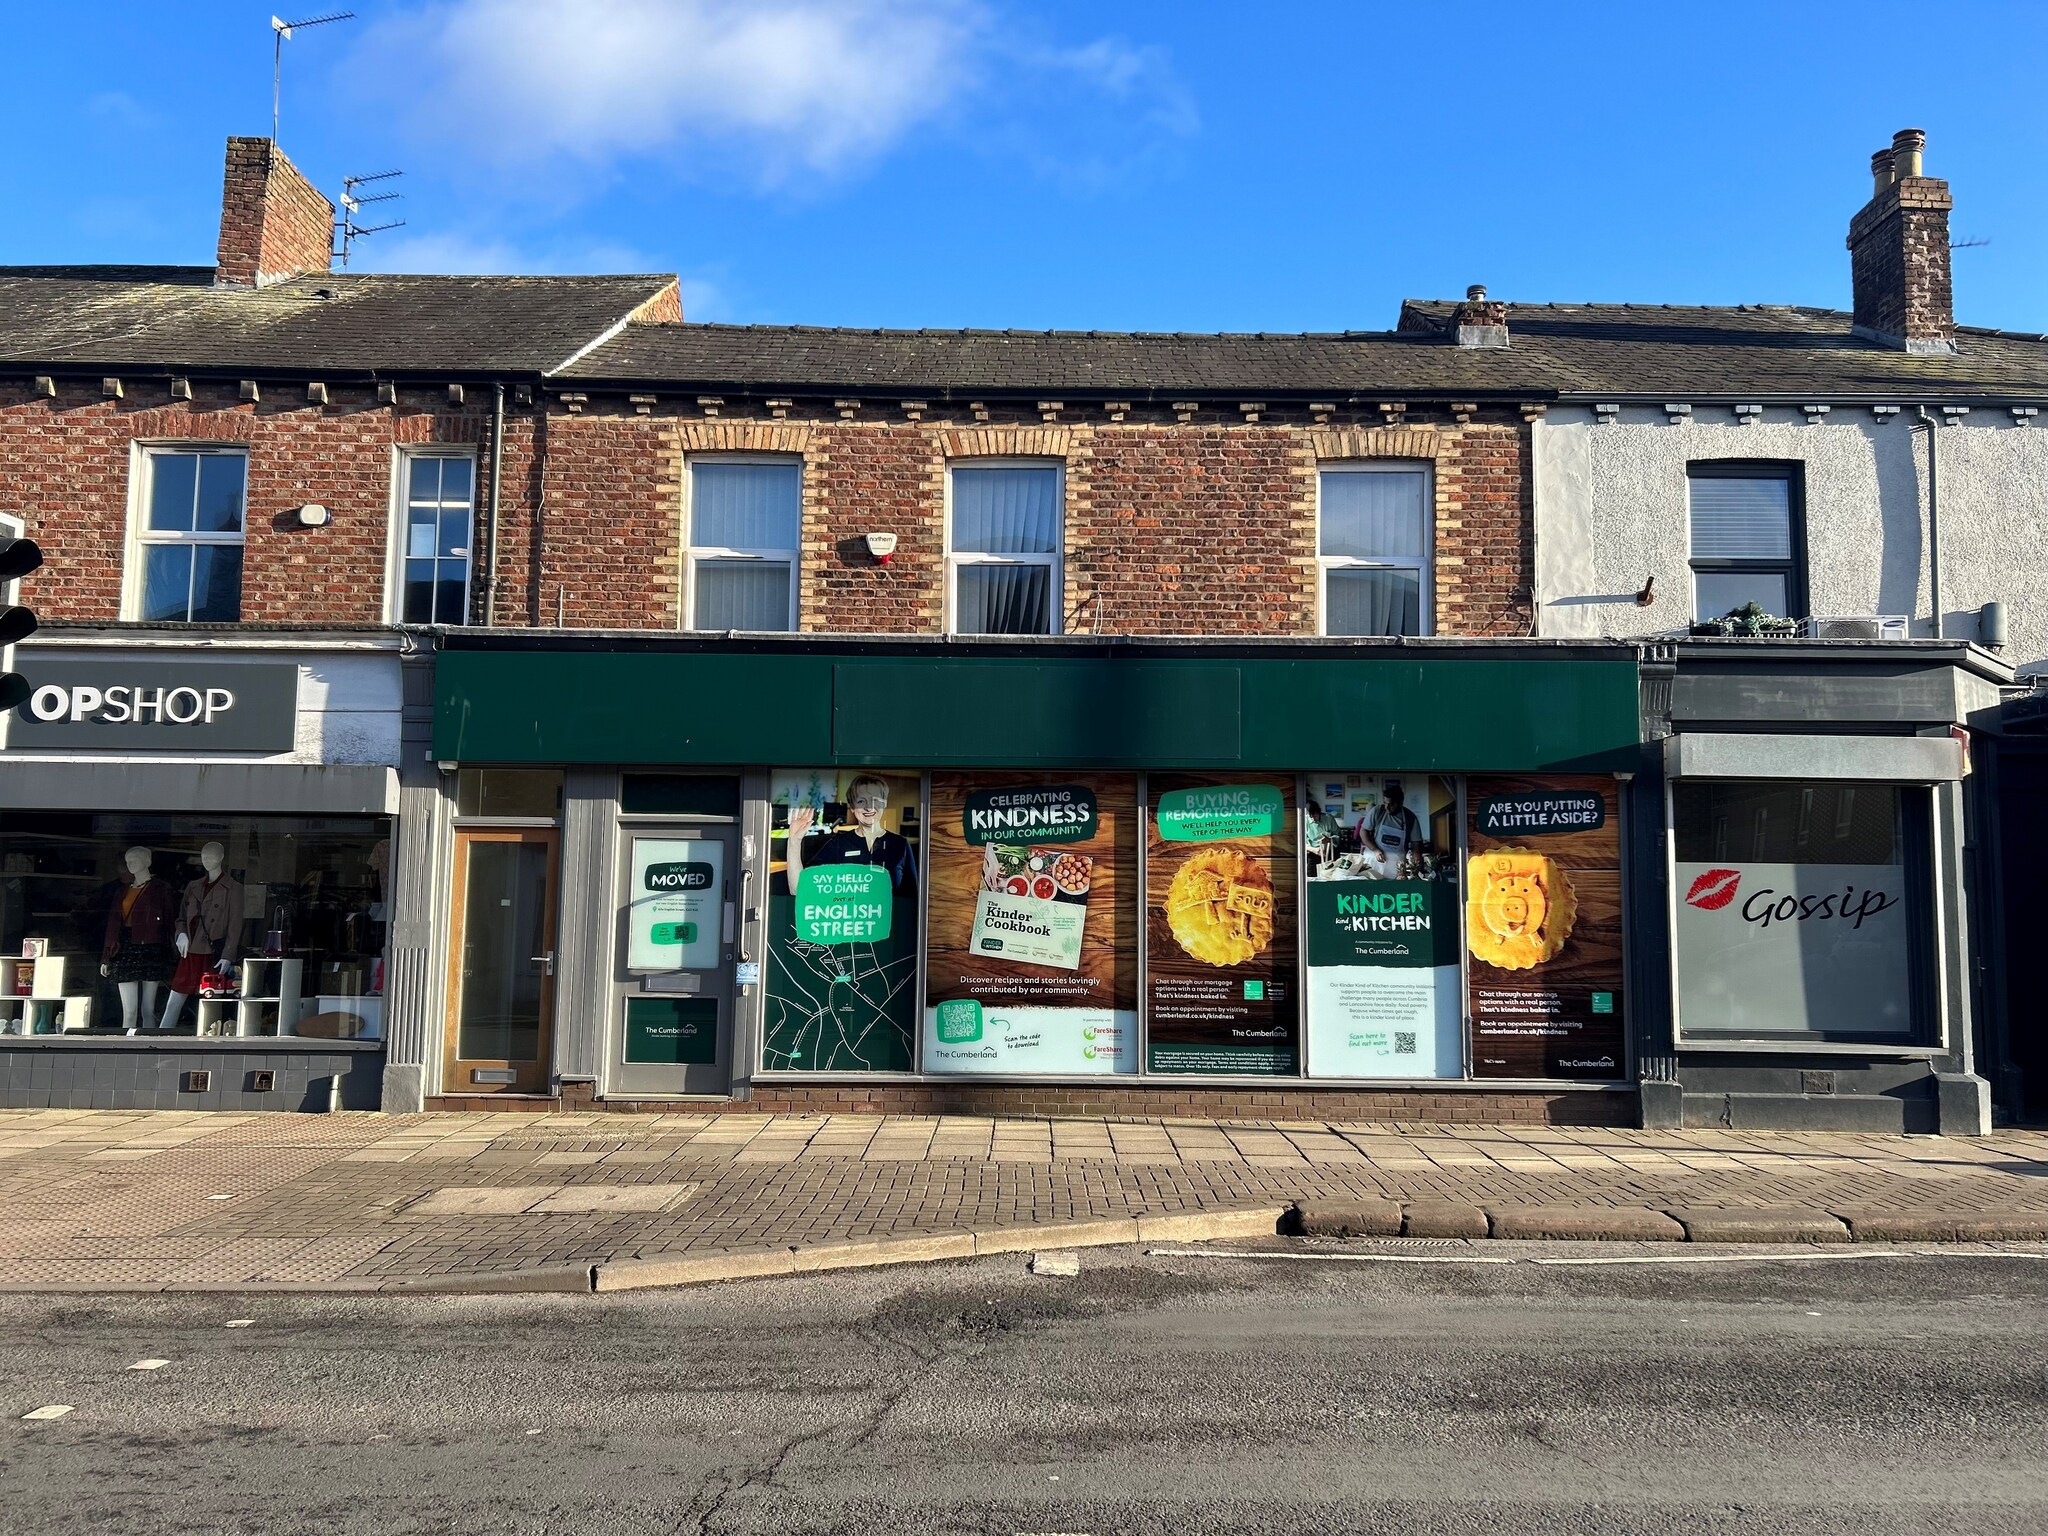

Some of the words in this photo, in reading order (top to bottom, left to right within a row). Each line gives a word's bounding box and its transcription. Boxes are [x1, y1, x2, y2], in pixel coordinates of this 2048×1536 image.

[30, 685, 235, 723] OPSHOP
[990, 792, 1071, 807] CELEBRATING
[1186, 791, 1250, 809] BUYING
[1489, 803, 1512, 814] ARE
[1515, 801, 1541, 813] YOU
[1544, 800, 1596, 811] PUTTING
[972, 803, 1090, 830] KINDNESS
[1166, 803, 1277, 821] REMORTGAGING?
[1488, 815, 1499, 828] A
[1503, 813, 1548, 827] LITTLE
[1551, 811, 1598, 825] ASIDE?
[981, 832, 992, 840] IN
[994, 829, 1015, 839] OUR
[1017, 825, 1083, 838] COMMUNITY
[1182, 822, 1204, 830] WE'LL
[652, 874, 705, 887] MOVED
[813, 874, 833, 883] SAY
[837, 874, 873, 883] HELLO
[817, 885, 833, 894] TO
[835, 884, 869, 893] DIANE
[1234, 894, 1268, 911] SOLD
[1337, 893, 1425, 915] KINDER
[1742, 886, 1899, 929] Gossip
[804, 904, 882, 920] ENGLISH
[986, 906, 1032, 922] Kinder
[811, 922, 876, 937] STREET
[985, 918, 1051, 936] Cookbook
[1352, 915, 1431, 932] KITCHEN
[1355, 947, 1368, 955] The
[995, 976, 1022, 985] recipes
[1024, 976, 1039, 984] and
[1068, 977, 1100, 986] lovingly
[1018, 986, 1028, 995] by
[1044, 986, 1090, 995] community.
[1226, 1006, 1248, 1014] visiting
[658, 1026, 697, 1034] Cumberland
[1480, 1028, 1568, 1036] cumberland.co.uk/kindness
